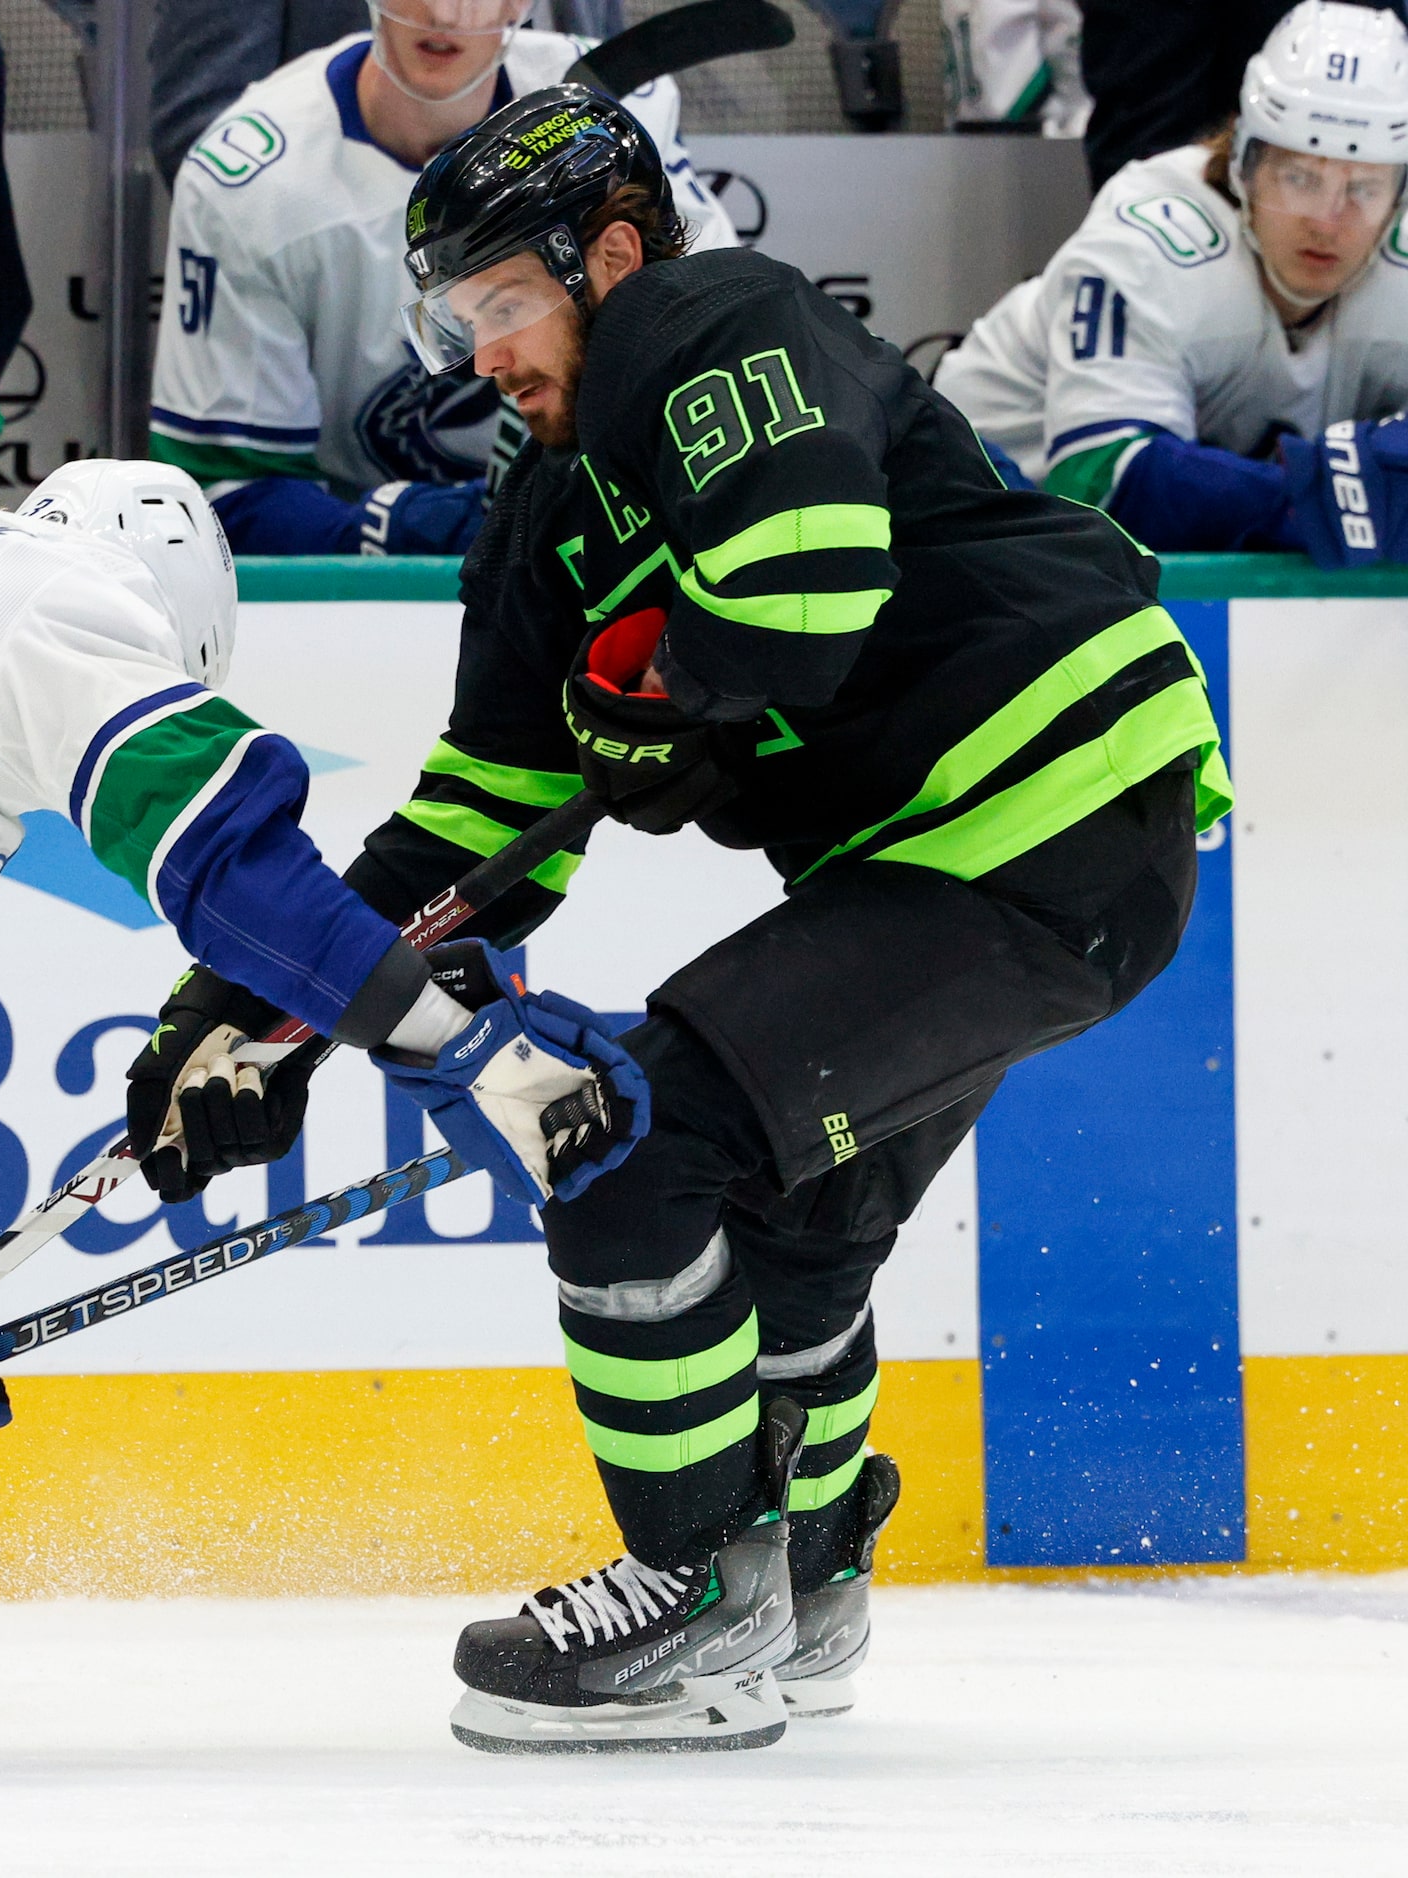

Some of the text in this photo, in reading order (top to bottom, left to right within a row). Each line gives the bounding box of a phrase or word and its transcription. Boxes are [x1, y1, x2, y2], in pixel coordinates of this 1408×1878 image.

[1327, 53, 1359, 83] 91
[520, 111, 573, 147] ENERGY
[530, 116, 596, 156] TRANSFER
[1070, 276, 1128, 359] 91
[664, 347, 826, 493] 91
[454, 1018, 493, 1060] CCM
[11, 1236, 255, 1354] JETSPEED
